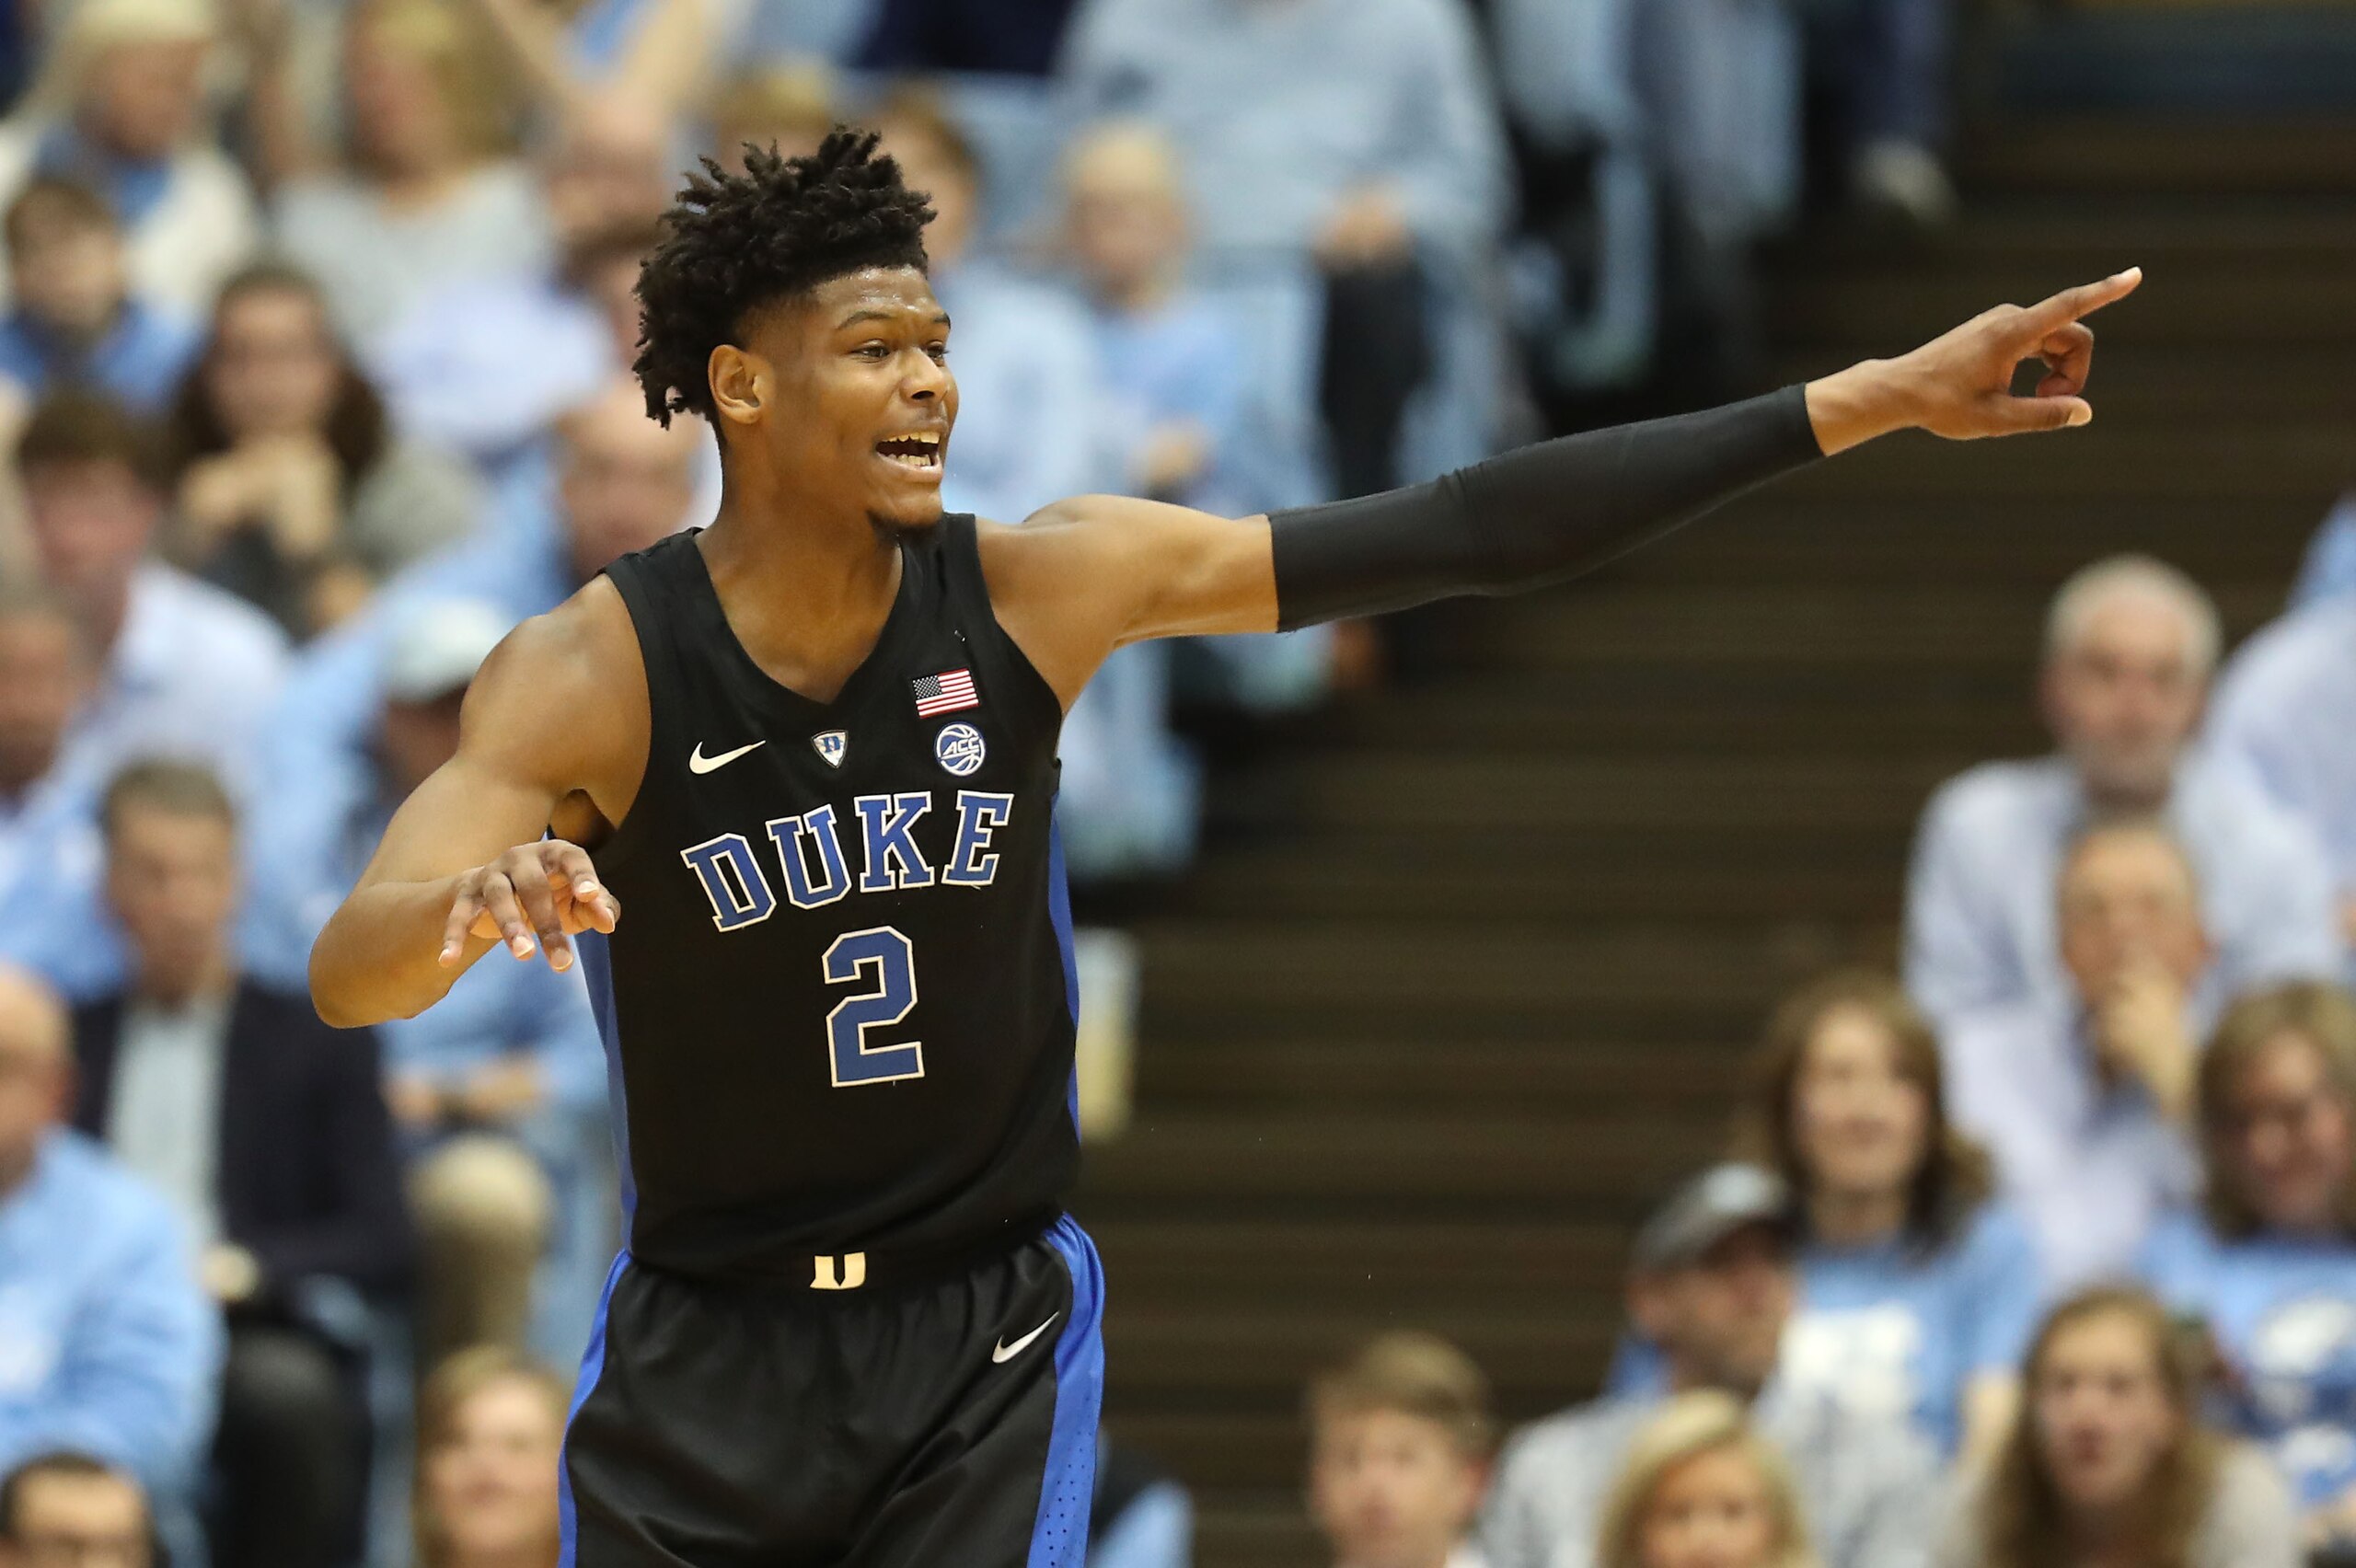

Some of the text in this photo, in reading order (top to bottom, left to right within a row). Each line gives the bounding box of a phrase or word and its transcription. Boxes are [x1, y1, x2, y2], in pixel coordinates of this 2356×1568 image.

[941, 737, 980, 755] ACC
[680, 790, 1014, 932] DUKE
[822, 925, 925, 1088] 2
